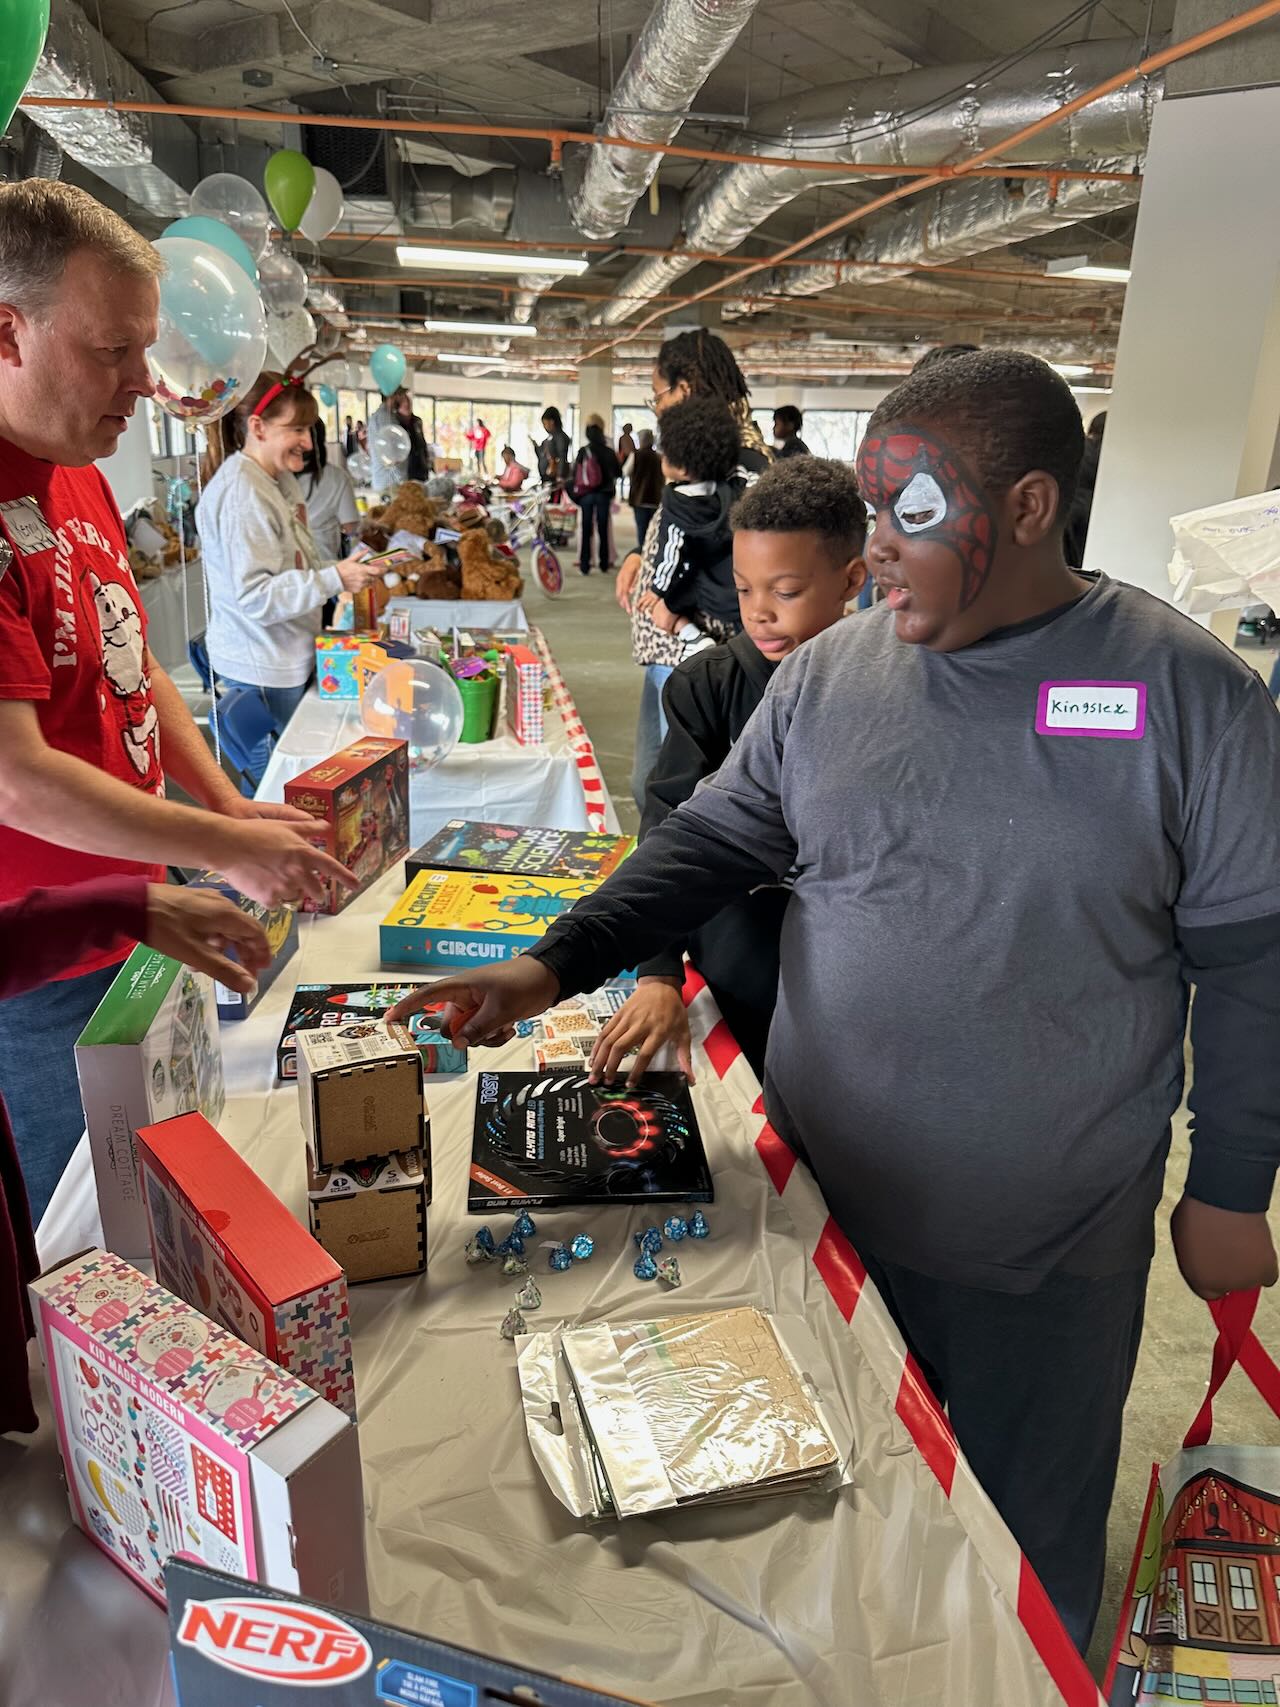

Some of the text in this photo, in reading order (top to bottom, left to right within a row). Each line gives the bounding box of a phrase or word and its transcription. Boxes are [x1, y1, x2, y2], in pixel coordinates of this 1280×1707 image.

[54, 527, 75, 605] JUS
[52, 608, 78, 669] I'M
[495, 828, 543, 869] LUMINOUS
[517, 830, 568, 872] SCIENCE
[408, 882, 443, 914] CIRCUIT
[428, 883, 460, 915] SCIENCE
[436, 939, 506, 959] CIRCUIT
[480, 1073, 499, 1105] TOSY
[525, 1110, 537, 1130] RING
[556, 1116, 566, 1143] Super Bright
[110, 1104, 136, 1202] DREAM COTTAGE
[525, 1130, 537, 1160] FLYING
[486, 1199, 509, 1207] RING
[510, 1198, 543, 1206] FLYING
[88, 1341, 106, 1362] KID
[108, 1356, 137, 1388] MADE
[139, 1380, 185, 1425] MODERN
[182, 1604, 360, 1665] NERF
